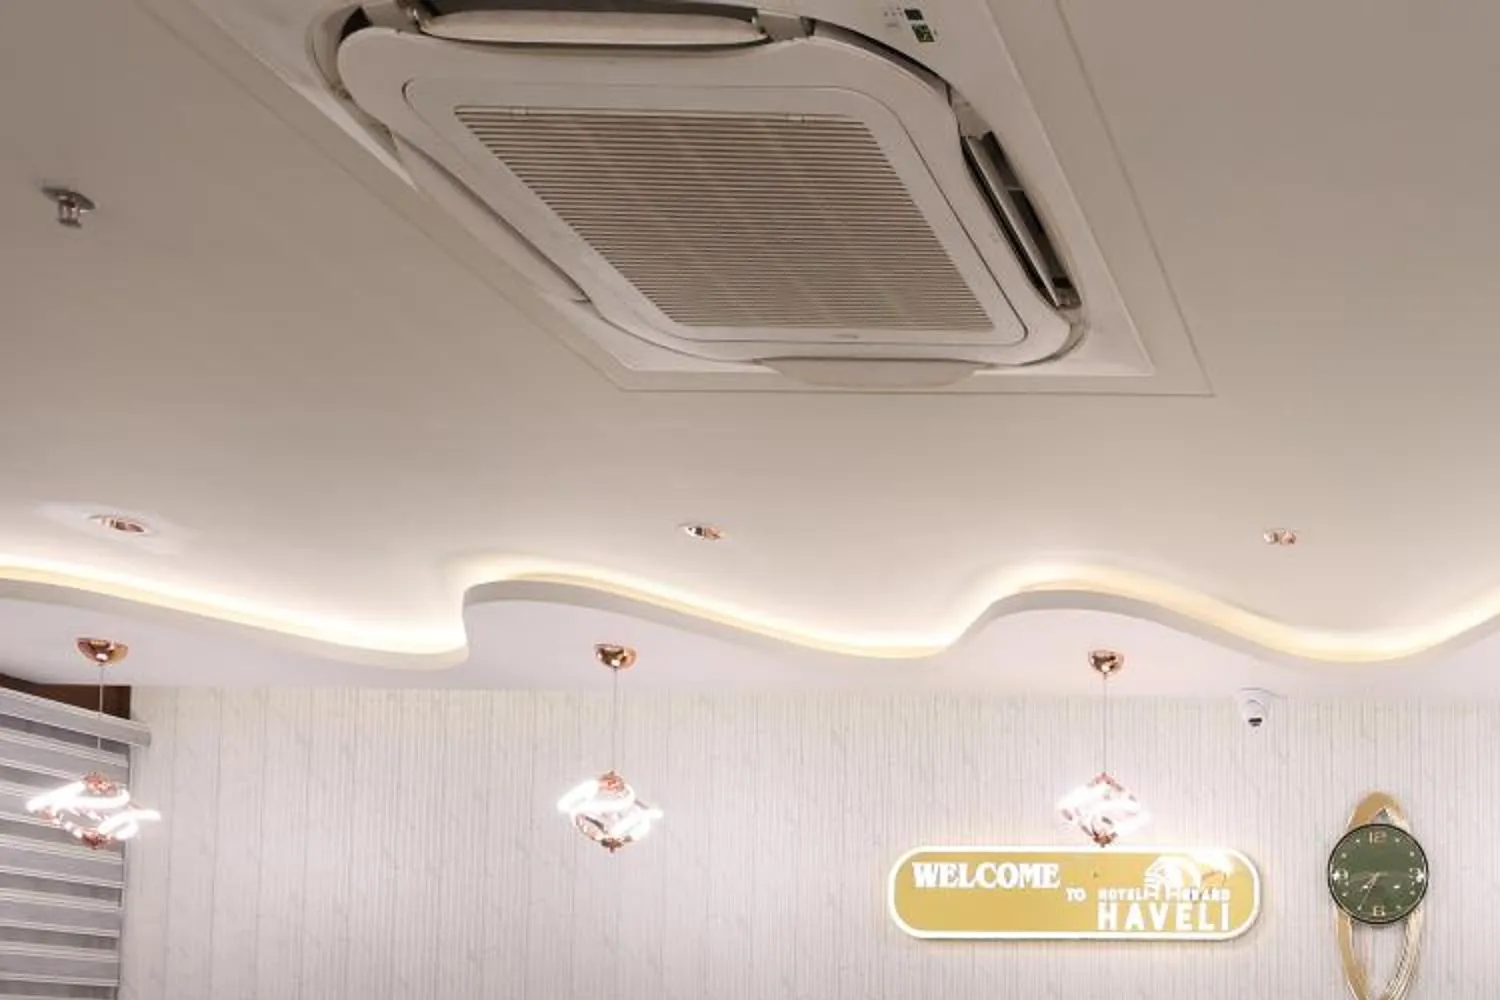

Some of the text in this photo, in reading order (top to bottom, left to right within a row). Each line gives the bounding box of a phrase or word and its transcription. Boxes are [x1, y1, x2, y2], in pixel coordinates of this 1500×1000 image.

[912, 860, 1060, 889] WELCOME
[1066, 887, 1087, 901] TO
[1097, 902, 1230, 931] HAVELI
